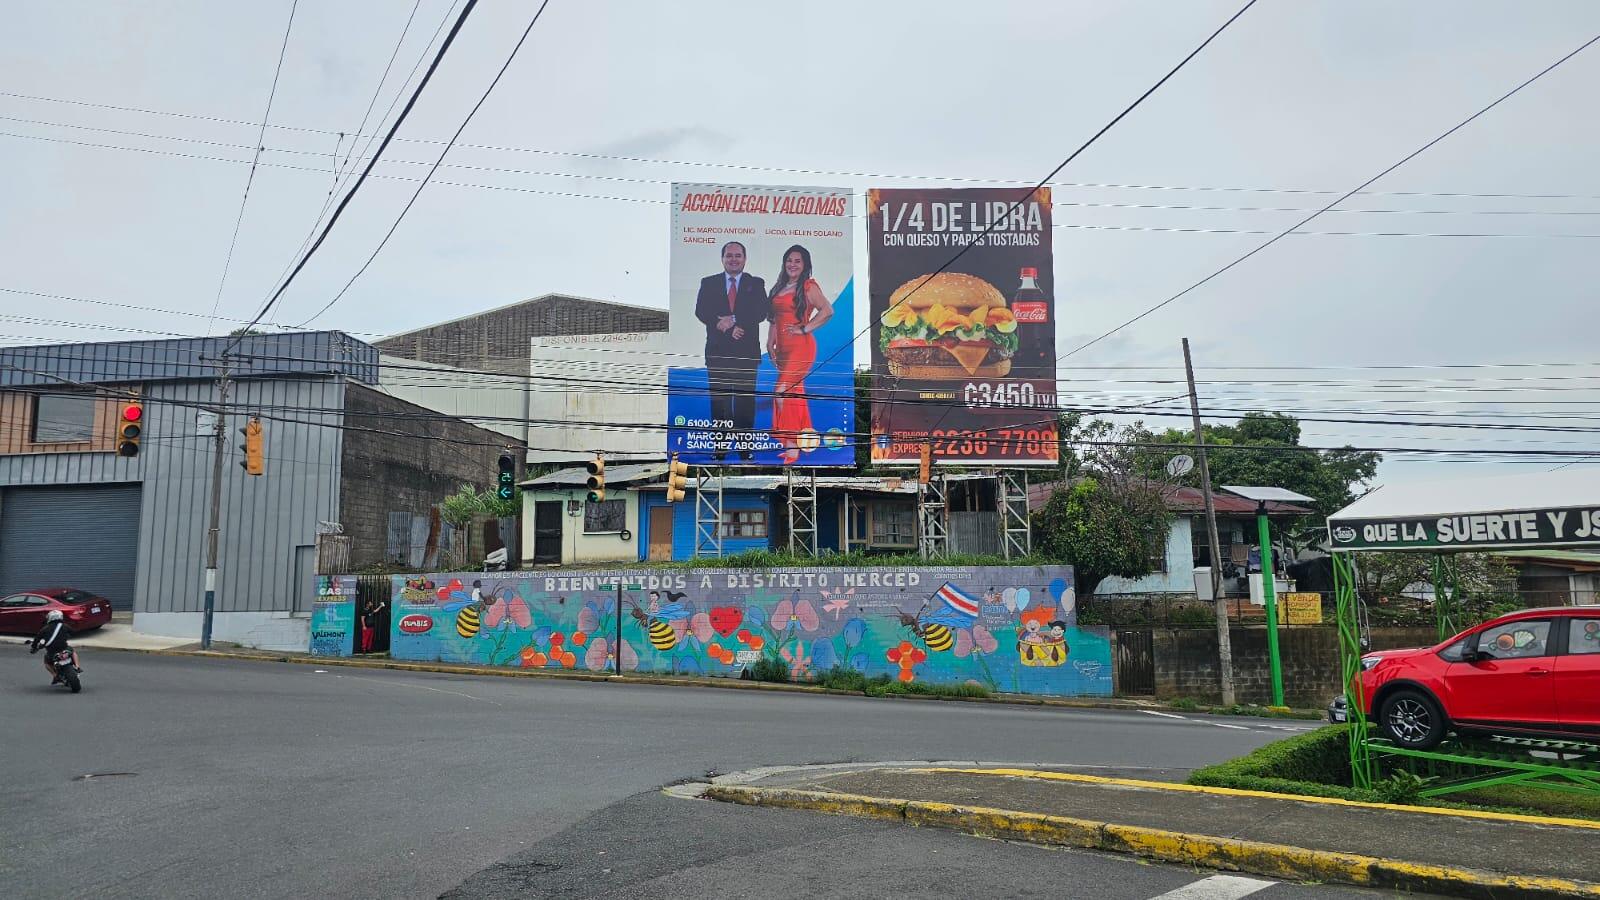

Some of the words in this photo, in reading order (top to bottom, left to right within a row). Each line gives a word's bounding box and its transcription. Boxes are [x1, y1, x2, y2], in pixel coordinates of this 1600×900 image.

[681, 190, 730, 212] ACCIÓN
[731, 194, 769, 214] LEGAL
[772, 195, 781, 214] Y
[781, 196, 815, 215] ALGO
[815, 192, 847, 216] MÁS
[879, 202, 925, 232] 1/4
[931, 202, 963, 232] DE
[970, 201, 1043, 231] LIBRA
[883, 234, 904, 247] CON
[906, 234, 940, 247] QUESO
[942, 234, 950, 247] Y
[951, 234, 985, 247] PAPAS
[987, 233, 1039, 247] TOSTADAS
[541, 335, 599, 345] DISPONIBLE
[687, 419, 734, 428] 6100-2710
[687, 431, 723, 441] MARCO
[725, 432, 770, 441] ANTONIO
[734, 441, 783, 450] ABOGADO
[1363, 523, 1398, 542] QUE
[1402, 522, 1427, 541] LA
[1436, 513, 1539, 543] SUERTE
[1546, 511, 1568, 538] Y
[545, 574, 687, 592] BIENVENIDOS
[701, 574, 713, 589] A
[727, 573, 828, 588] DISTRITO
[843, 572, 920, 587] MERCED
